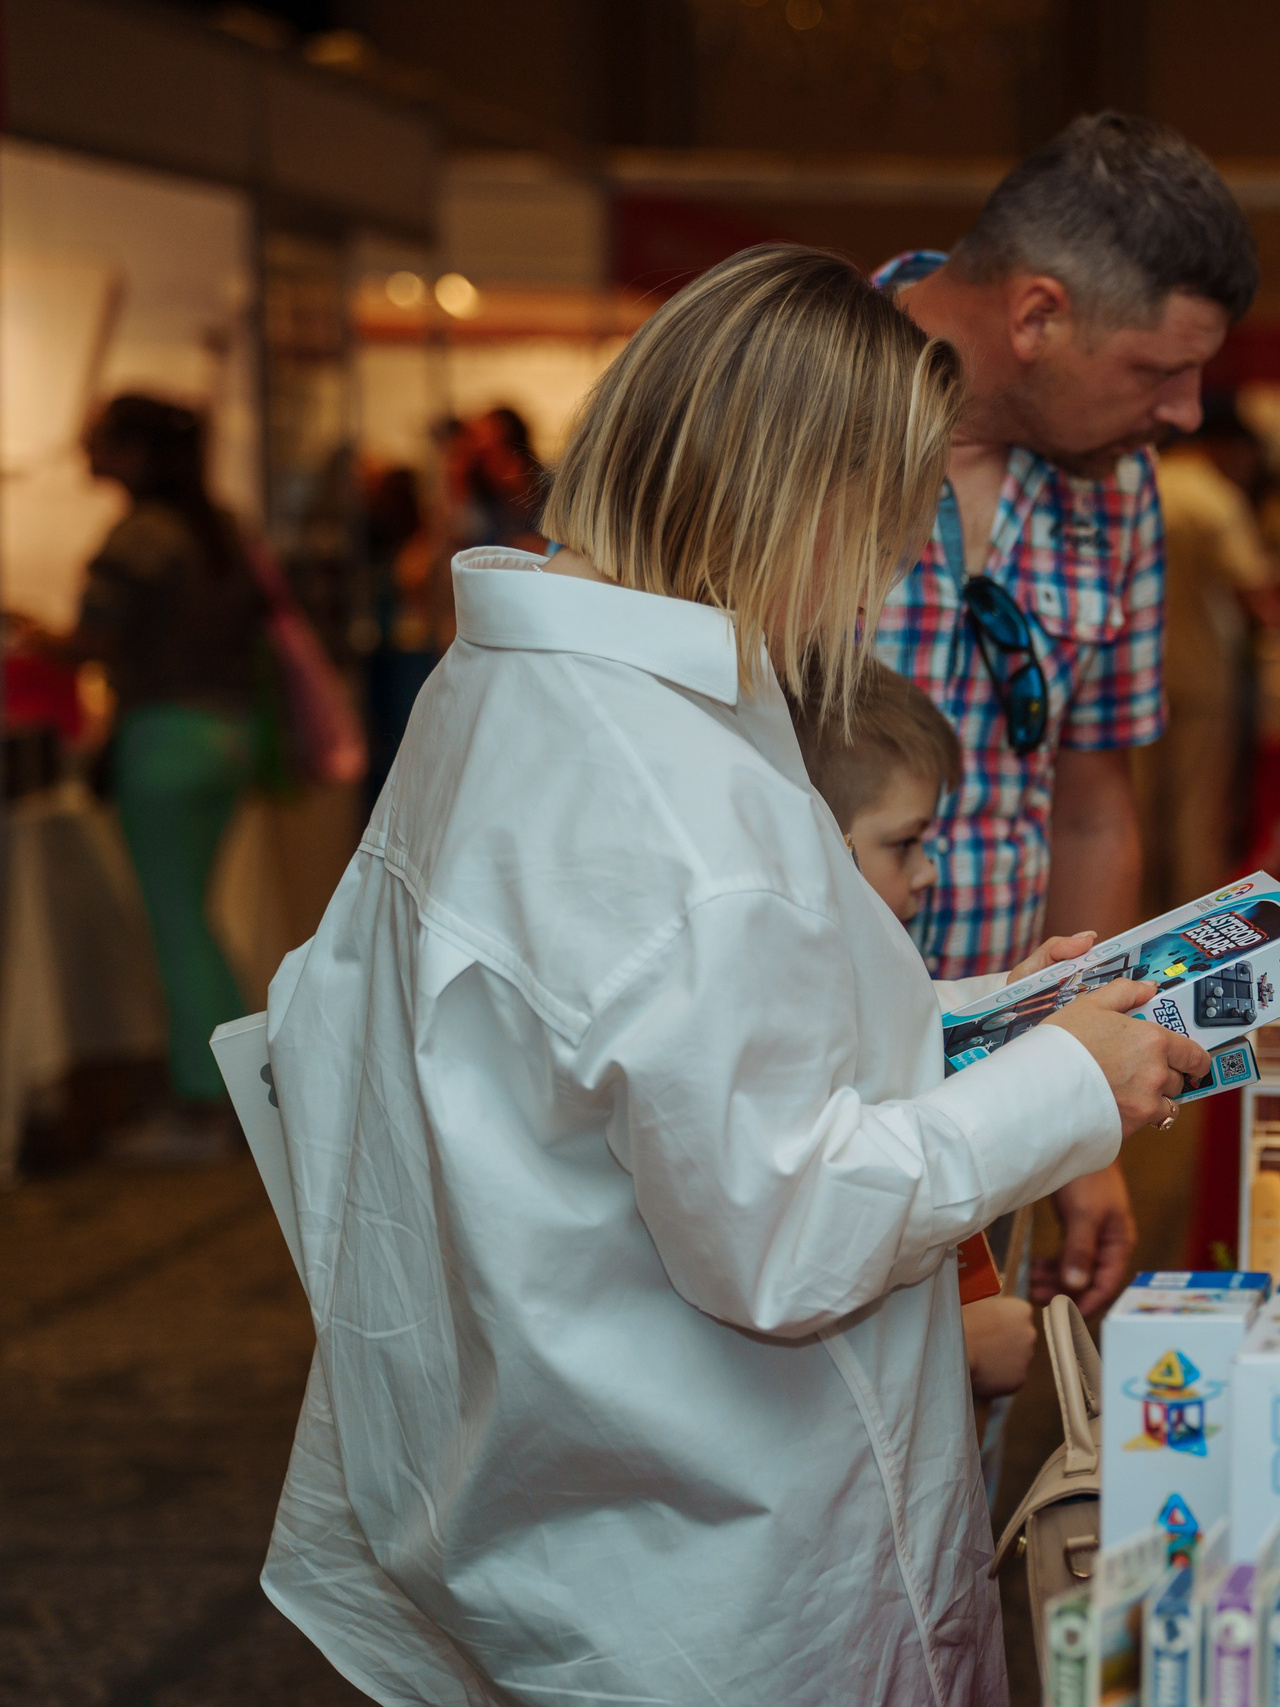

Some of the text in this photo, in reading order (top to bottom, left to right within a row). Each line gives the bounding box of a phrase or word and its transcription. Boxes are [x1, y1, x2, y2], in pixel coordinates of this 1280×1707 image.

[1184, 924, 1237, 956] ESCAPE
[1204, 913, 1263, 948] ASTEROID
[1161, 999, 1188, 1038] ASTER
